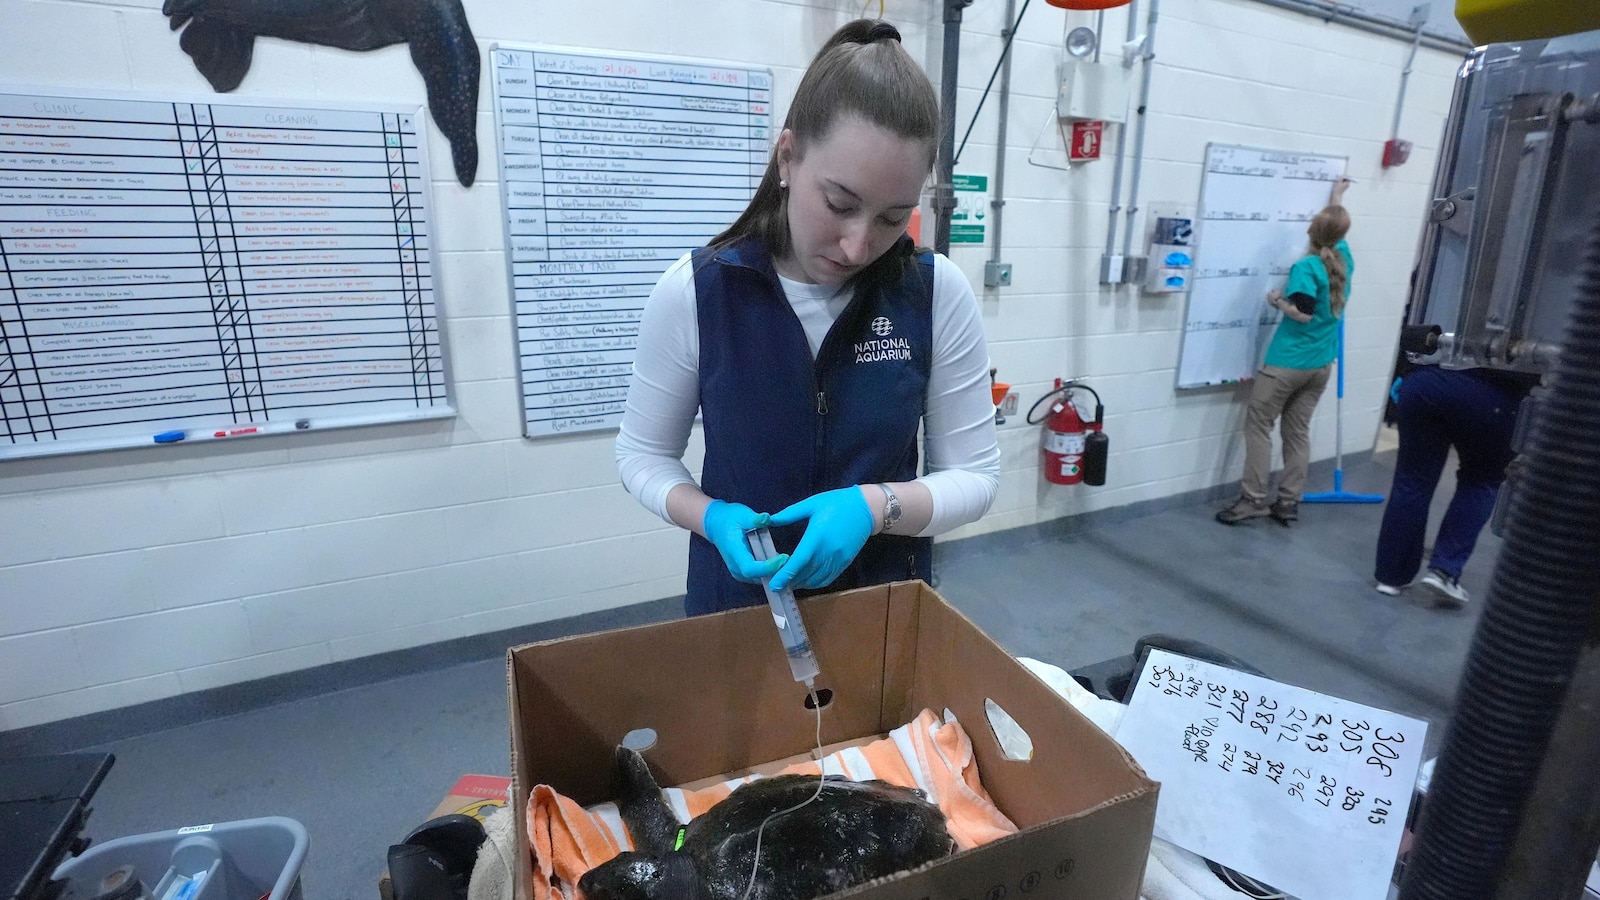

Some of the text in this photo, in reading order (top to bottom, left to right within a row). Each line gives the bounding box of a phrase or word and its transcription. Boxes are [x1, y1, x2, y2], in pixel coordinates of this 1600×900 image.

[500, 52, 521, 66] DAY
[538, 58, 556, 70] Week
[560, 60, 567, 71] of
[33, 102, 83, 115] CLINIC
[264, 113, 318, 127] CLEANING
[46, 208, 97, 218] FEEDING
[539, 262, 617, 274] MONTHLY TASKS
[62, 318, 135, 331] MISCELLANEOUS
[854, 338, 911, 354] NATIONAL
[855, 349, 911, 365] AQUARIUM
[1148, 665, 1171, 688] 307
[1163, 670, 1184, 697] 276
[1184, 676, 1203, 698] 294
[1204, 682, 1227, 709] 321
[1226, 689, 1250, 724] 277
[1249, 695, 1279, 736] 288
[1276, 709, 1308, 745] 292
[1304, 713, 1333, 754] 293
[1338, 718, 1370, 755] 305
[1217, 744, 1238, 773] 274
[1242, 752, 1262, 776] 279
[1365, 727, 1406, 778] 308
[1265, 759, 1285, 785] 324
[1287, 768, 1311, 802] 296
[1313, 777, 1337, 808] 297
[1341, 785, 1364, 811] 320
[1367, 797, 1393, 825] 295
